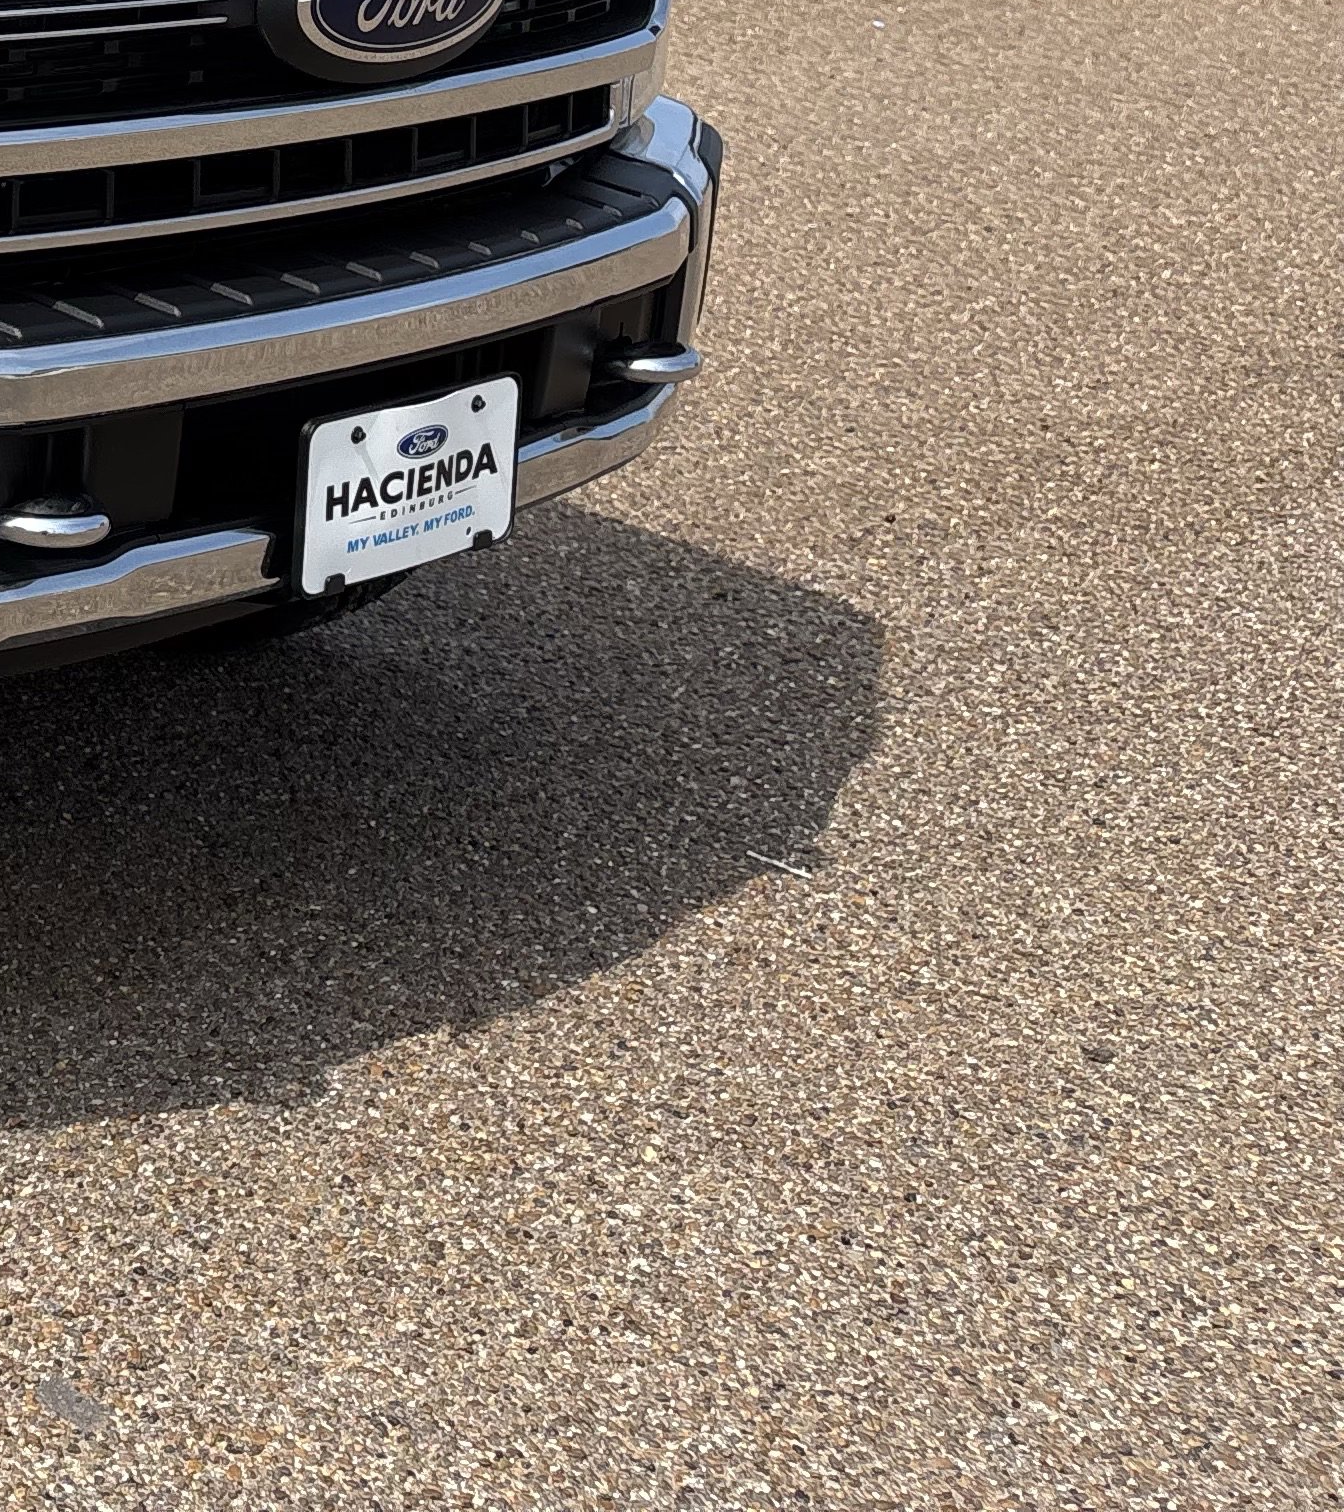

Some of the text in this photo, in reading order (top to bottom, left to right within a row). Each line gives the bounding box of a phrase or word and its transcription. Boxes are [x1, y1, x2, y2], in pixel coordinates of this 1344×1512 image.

[408, 429, 442, 455] Ford
[324, 442, 498, 522] HACIENDA
[379, 491, 454, 521] EDINBURG
[346, 535, 370, 554] MY
[423, 515, 444, 532] MY
